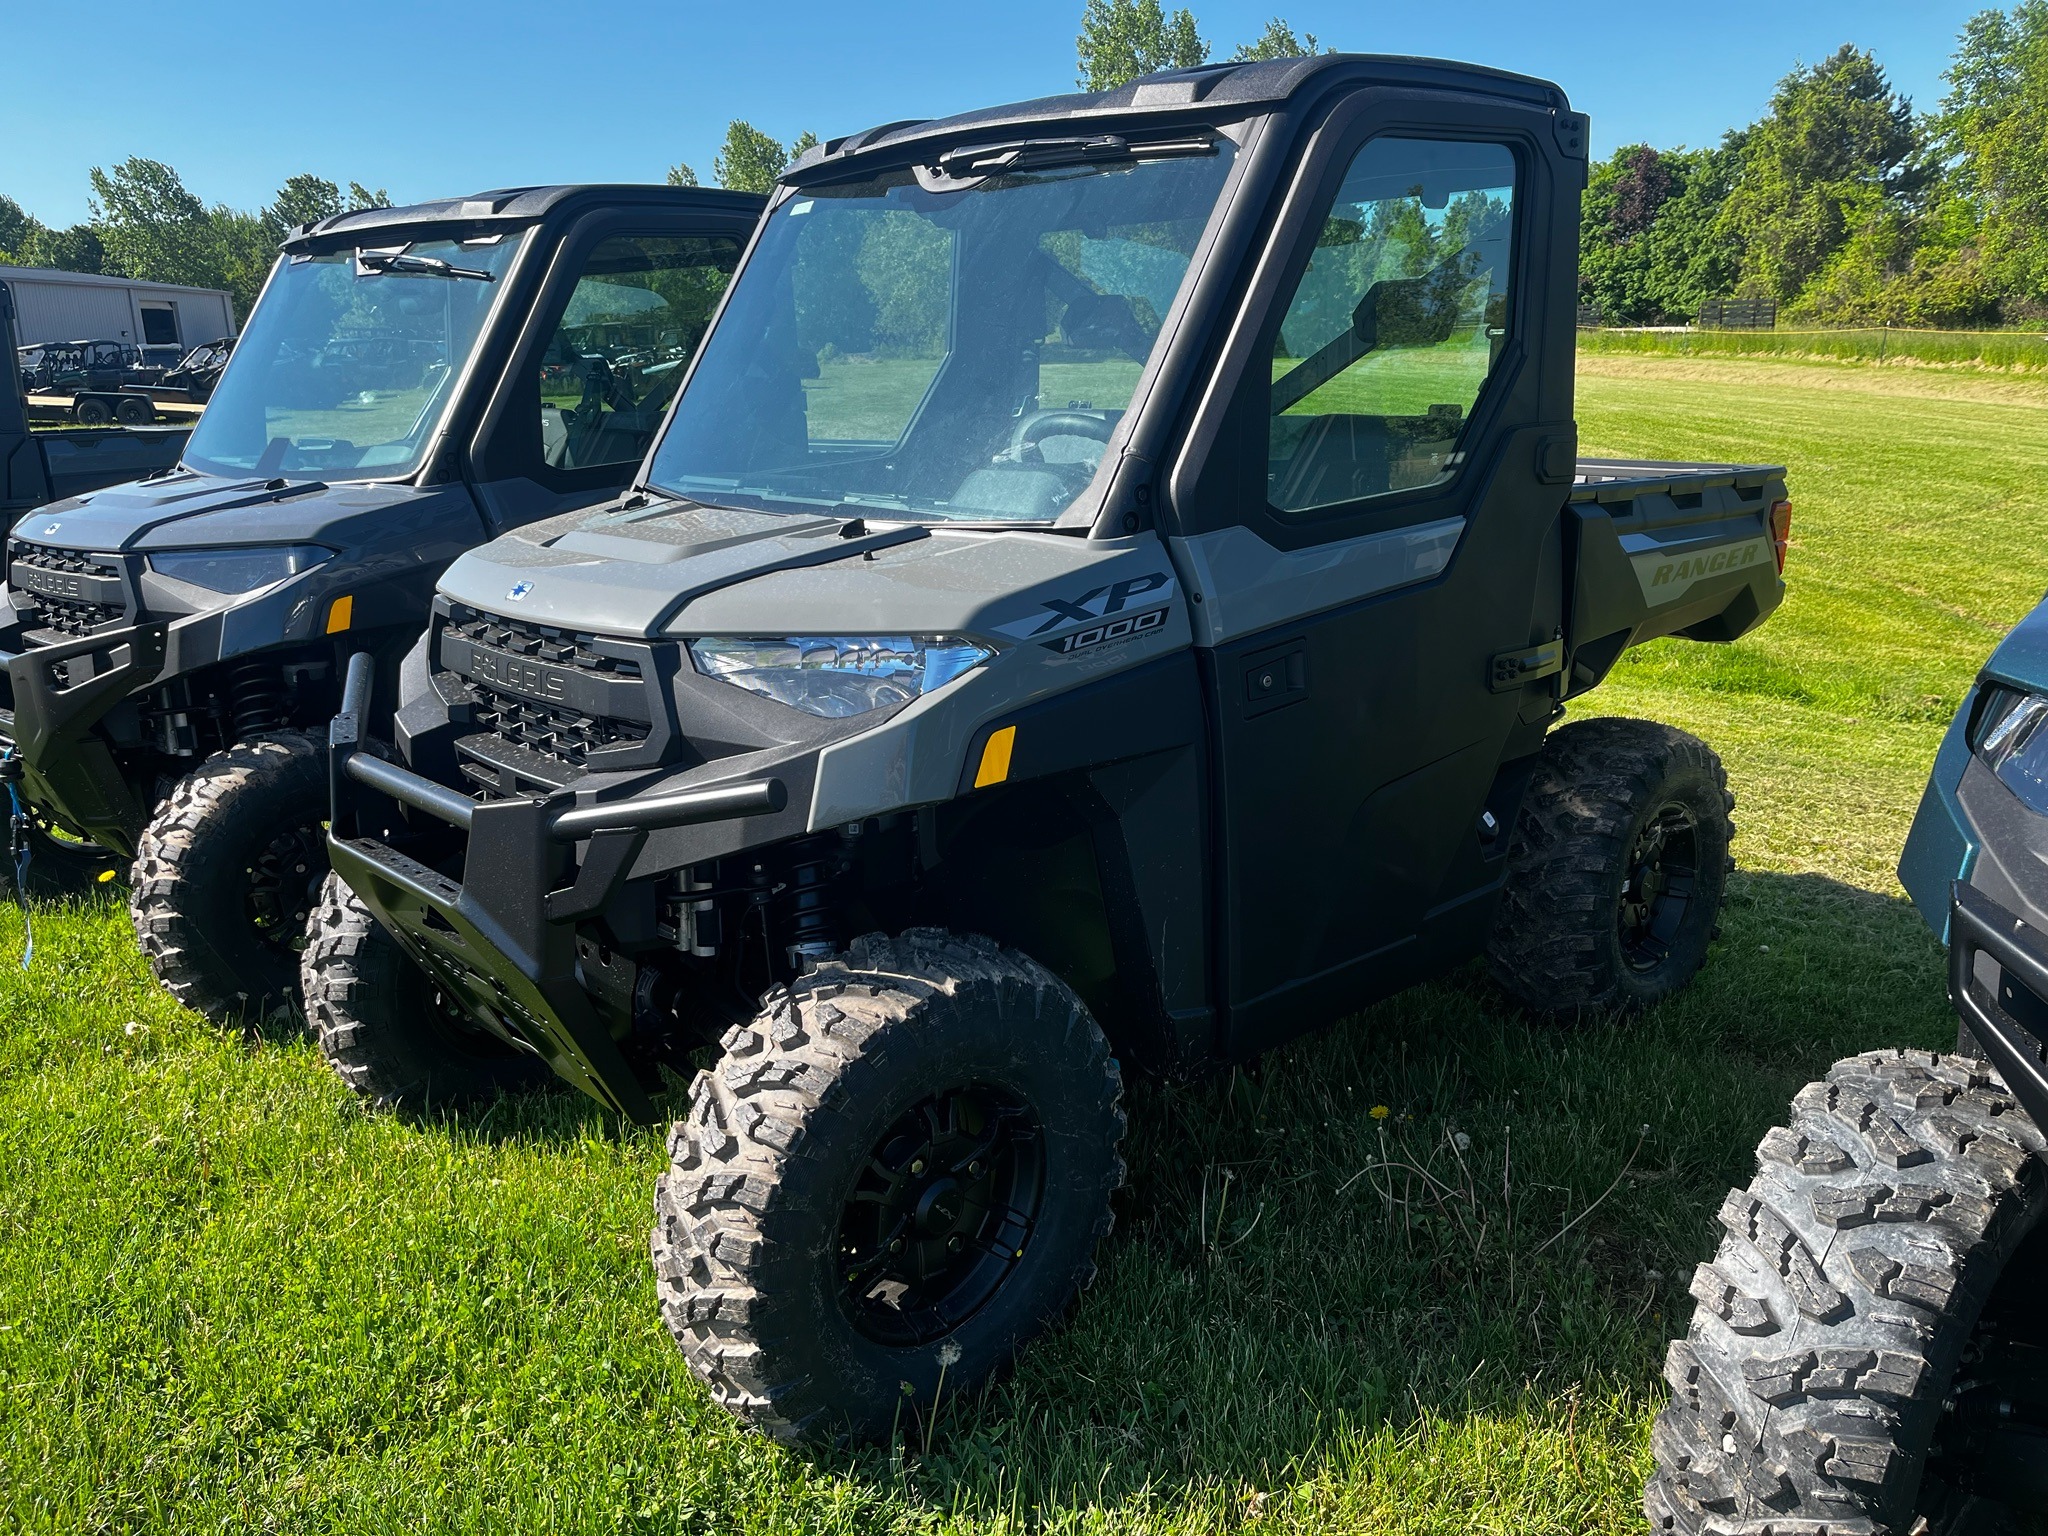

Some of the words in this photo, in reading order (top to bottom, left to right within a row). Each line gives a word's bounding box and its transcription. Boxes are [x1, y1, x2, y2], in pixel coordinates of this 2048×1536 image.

[27, 571, 79, 597] POLARIS
[1652, 545, 1759, 587] RANGER
[1027, 571, 1170, 637] XP
[1063, 611, 1163, 652] 1000
[1068, 651, 1094, 661] DUAL
[1095, 634, 1144, 652] OVERHEAD
[1145, 628, 1164, 638] CAM
[471, 649, 565, 700] POLARIS
